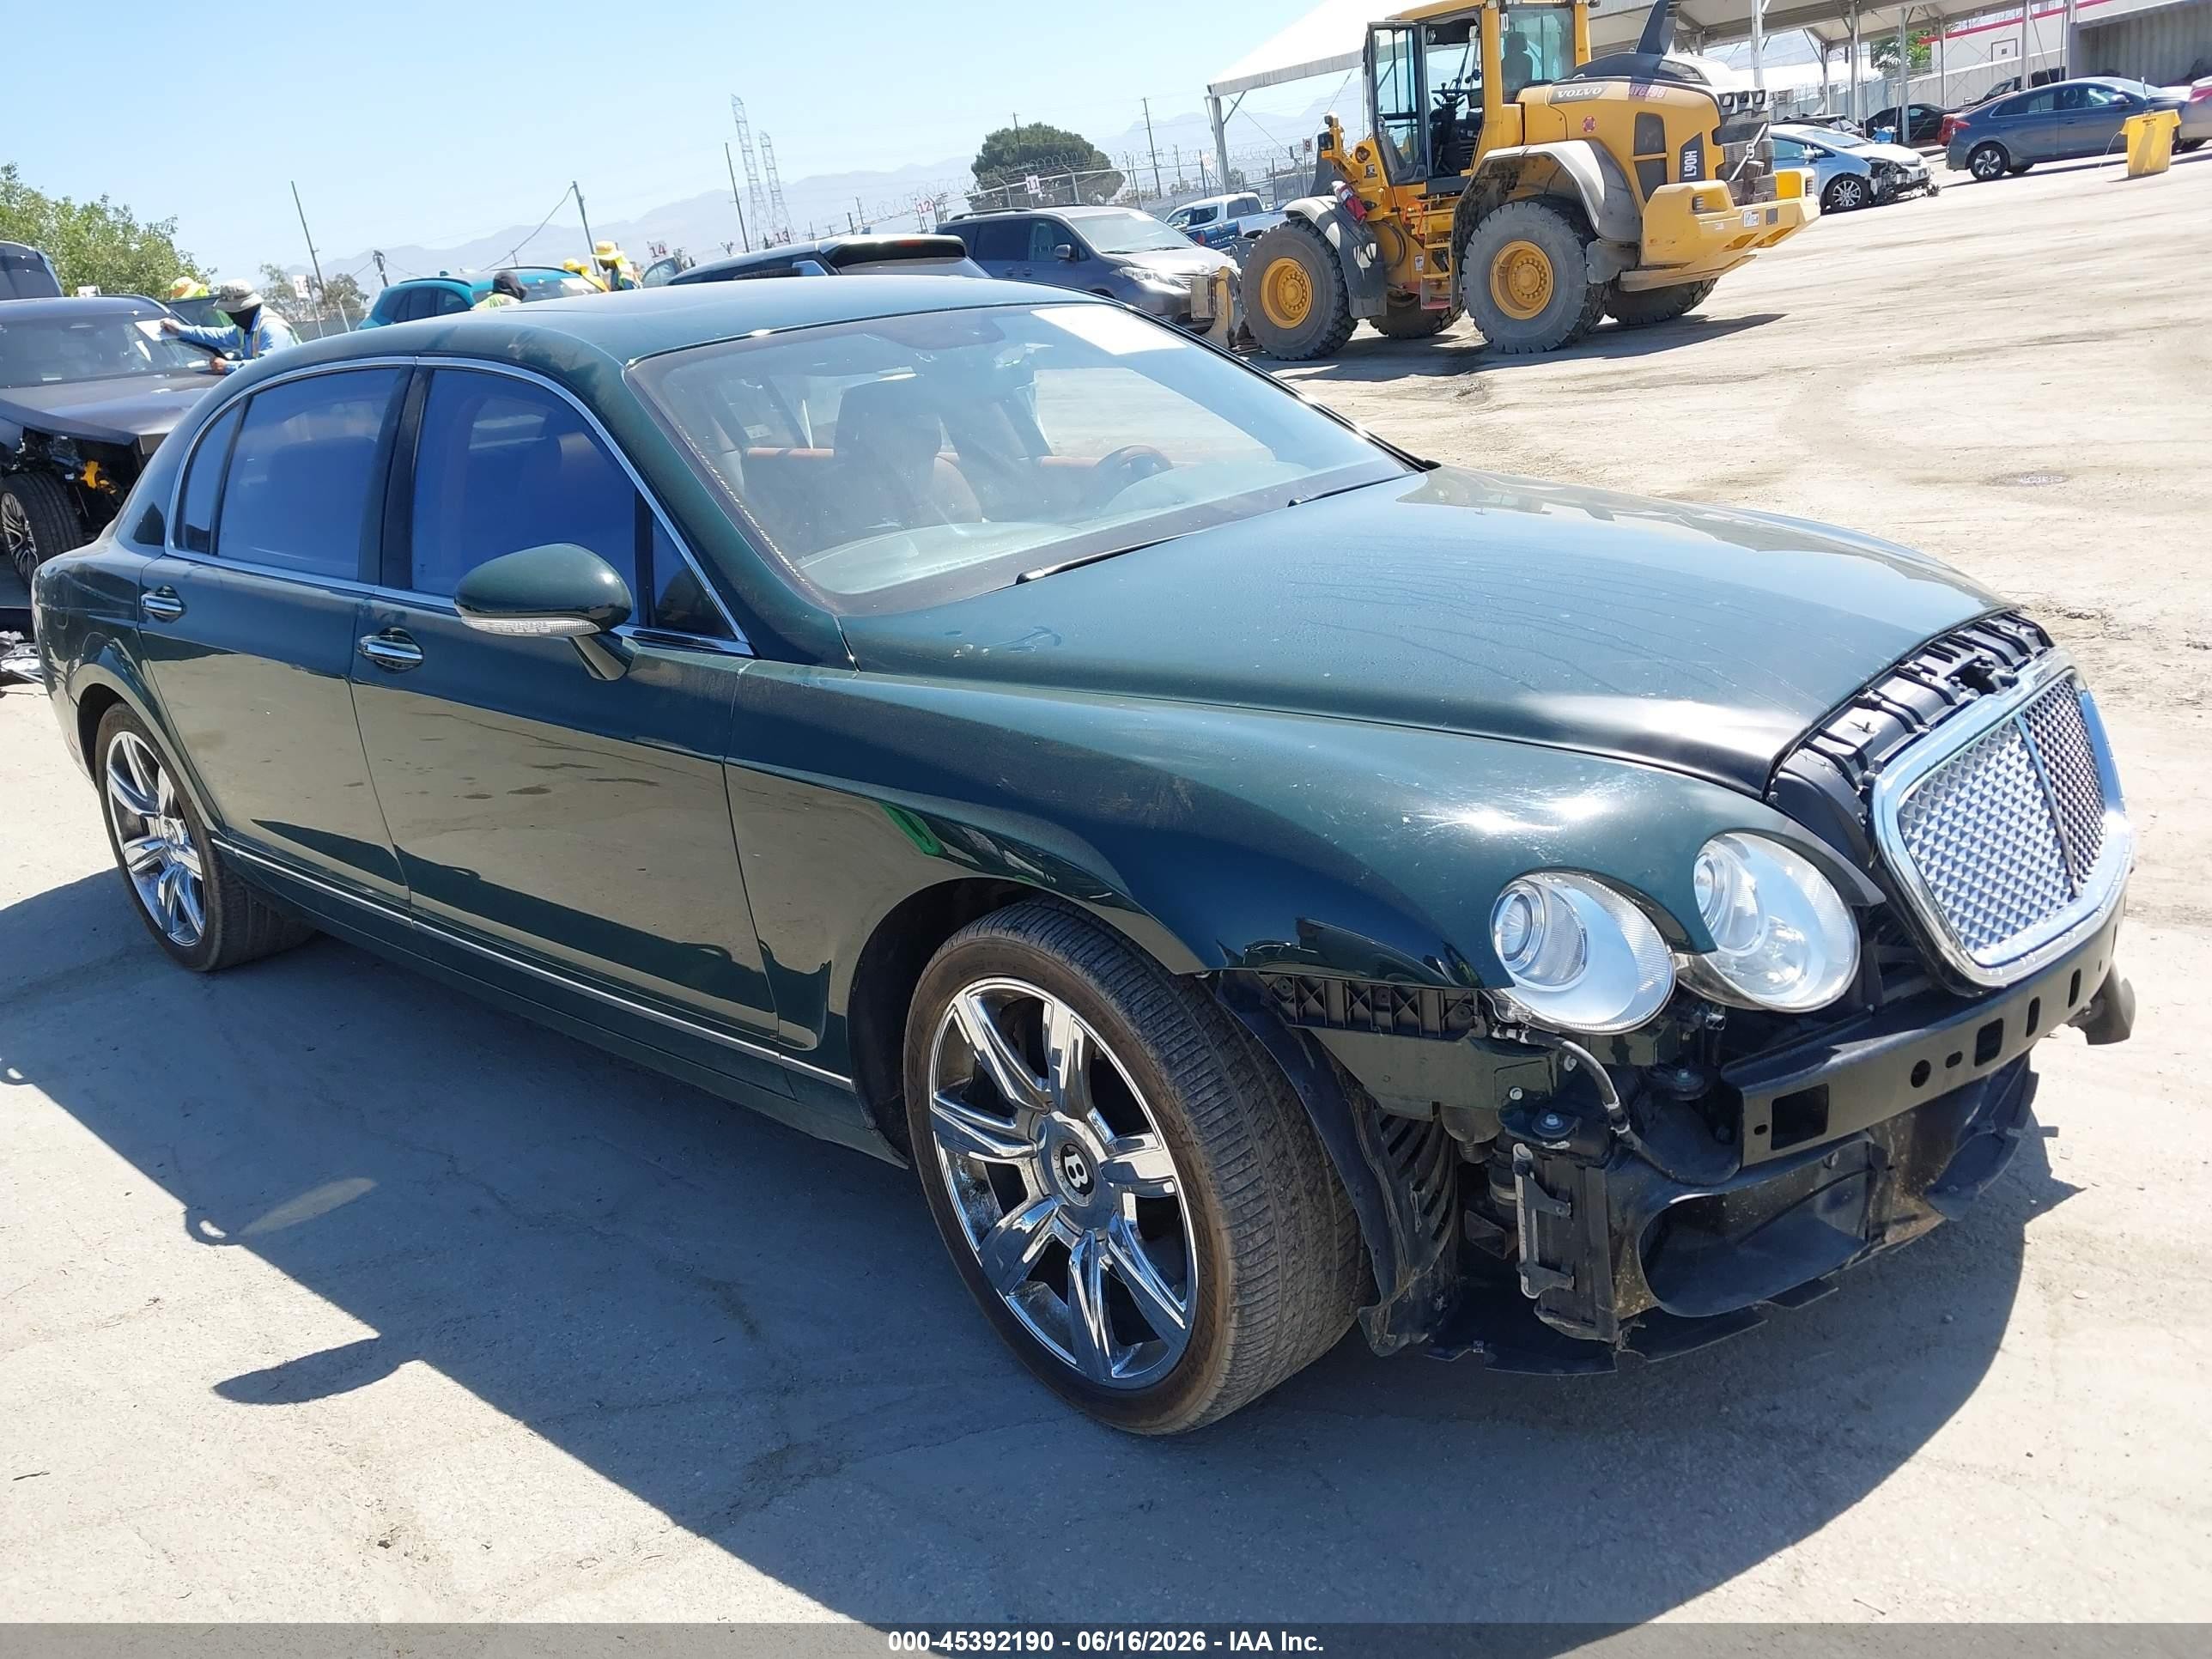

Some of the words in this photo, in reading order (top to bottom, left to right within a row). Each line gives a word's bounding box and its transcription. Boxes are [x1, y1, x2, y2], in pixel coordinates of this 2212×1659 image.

[1558, 86, 1602, 98] VOLVO
[1305, 140, 1310, 151] 9
[1683, 150, 1698, 178] L90H
[919, 201, 933, 213] 12
[775, 231, 790, 243] 13
[649, 244, 666, 258] 14
